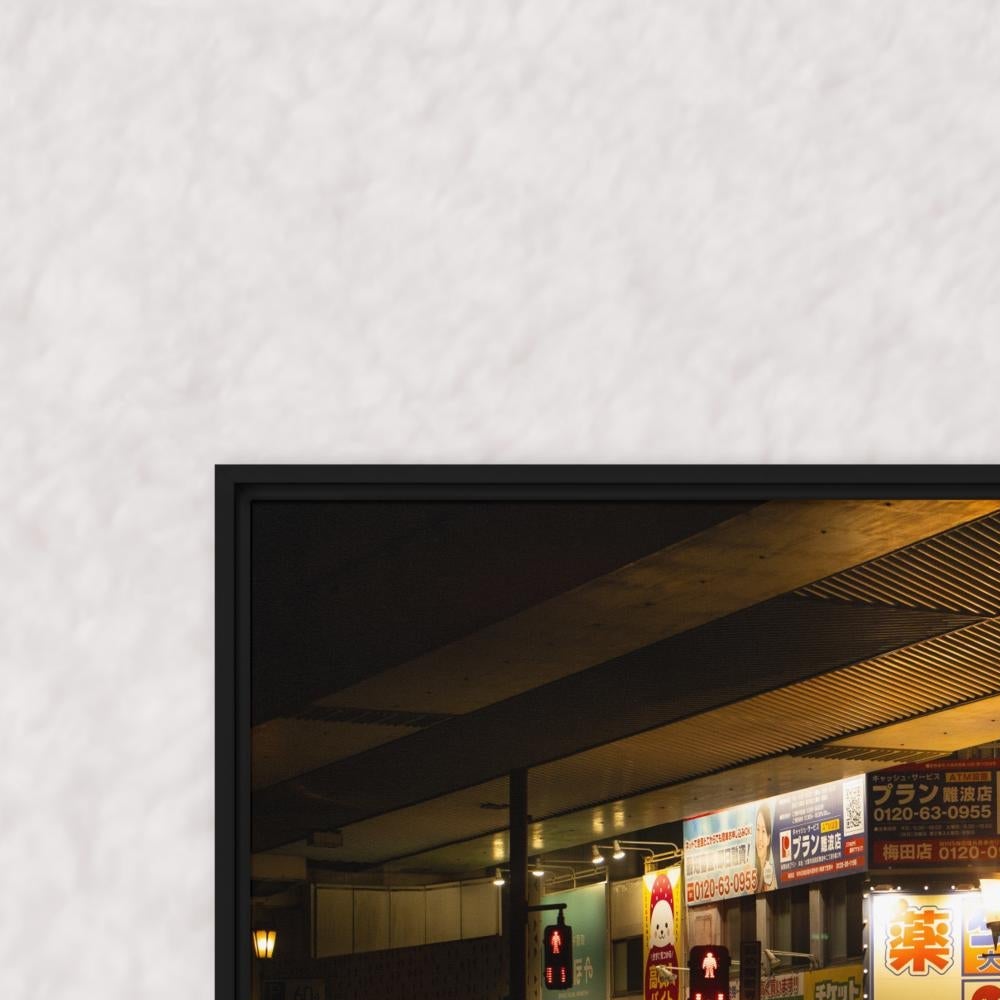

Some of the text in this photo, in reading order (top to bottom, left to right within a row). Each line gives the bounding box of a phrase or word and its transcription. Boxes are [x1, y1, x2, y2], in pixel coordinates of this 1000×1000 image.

[872, 783, 992, 805] プラン 難波店
[873, 805, 992, 821] 0120-63-0955
[793, 834, 820, 860] プラン
[883, 843, 932, 860] 梅田店
[889, 909, 949, 973] 薬
